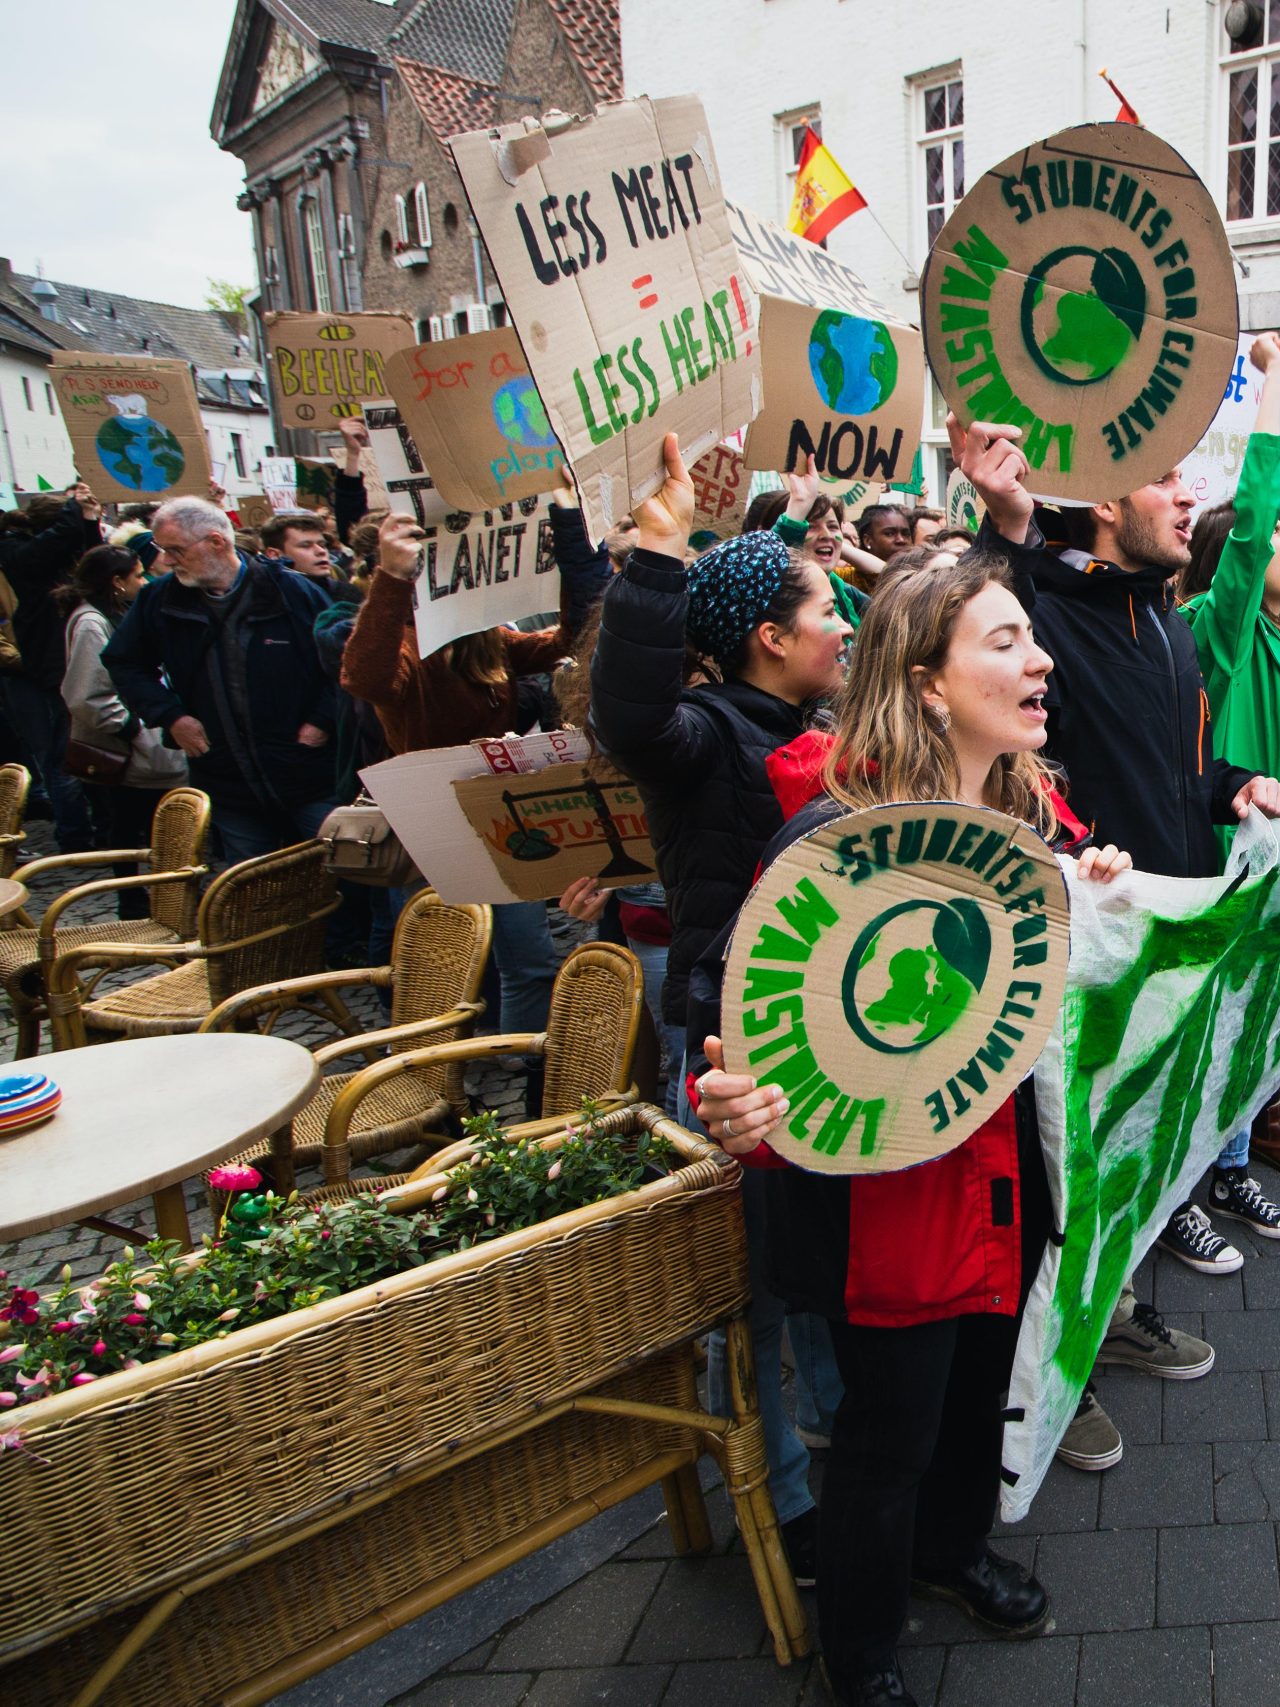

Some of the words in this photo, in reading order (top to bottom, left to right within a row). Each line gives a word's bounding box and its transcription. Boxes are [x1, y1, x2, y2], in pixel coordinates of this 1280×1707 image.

[515, 190, 607, 286] LESS
[612, 153, 701, 248] MEAT
[1001, 160, 1172, 248] STUDENTS
[1154, 239, 1197, 320] FOR
[98, 378, 132, 390] SEND
[413, 347, 475, 400] for
[489, 352, 524, 378] a
[573, 337, 660, 445] LESS
[660, 275, 751, 396] HEAT!
[1101, 330, 1194, 460] CLIMATE
[785, 419, 904, 481] NOW
[614, 791, 637, 804] IS
[838, 818, 1038, 896] STUDENTS
[1004, 891, 1048, 970] FOR
[925, 980, 1043, 1133] CLIMATE
